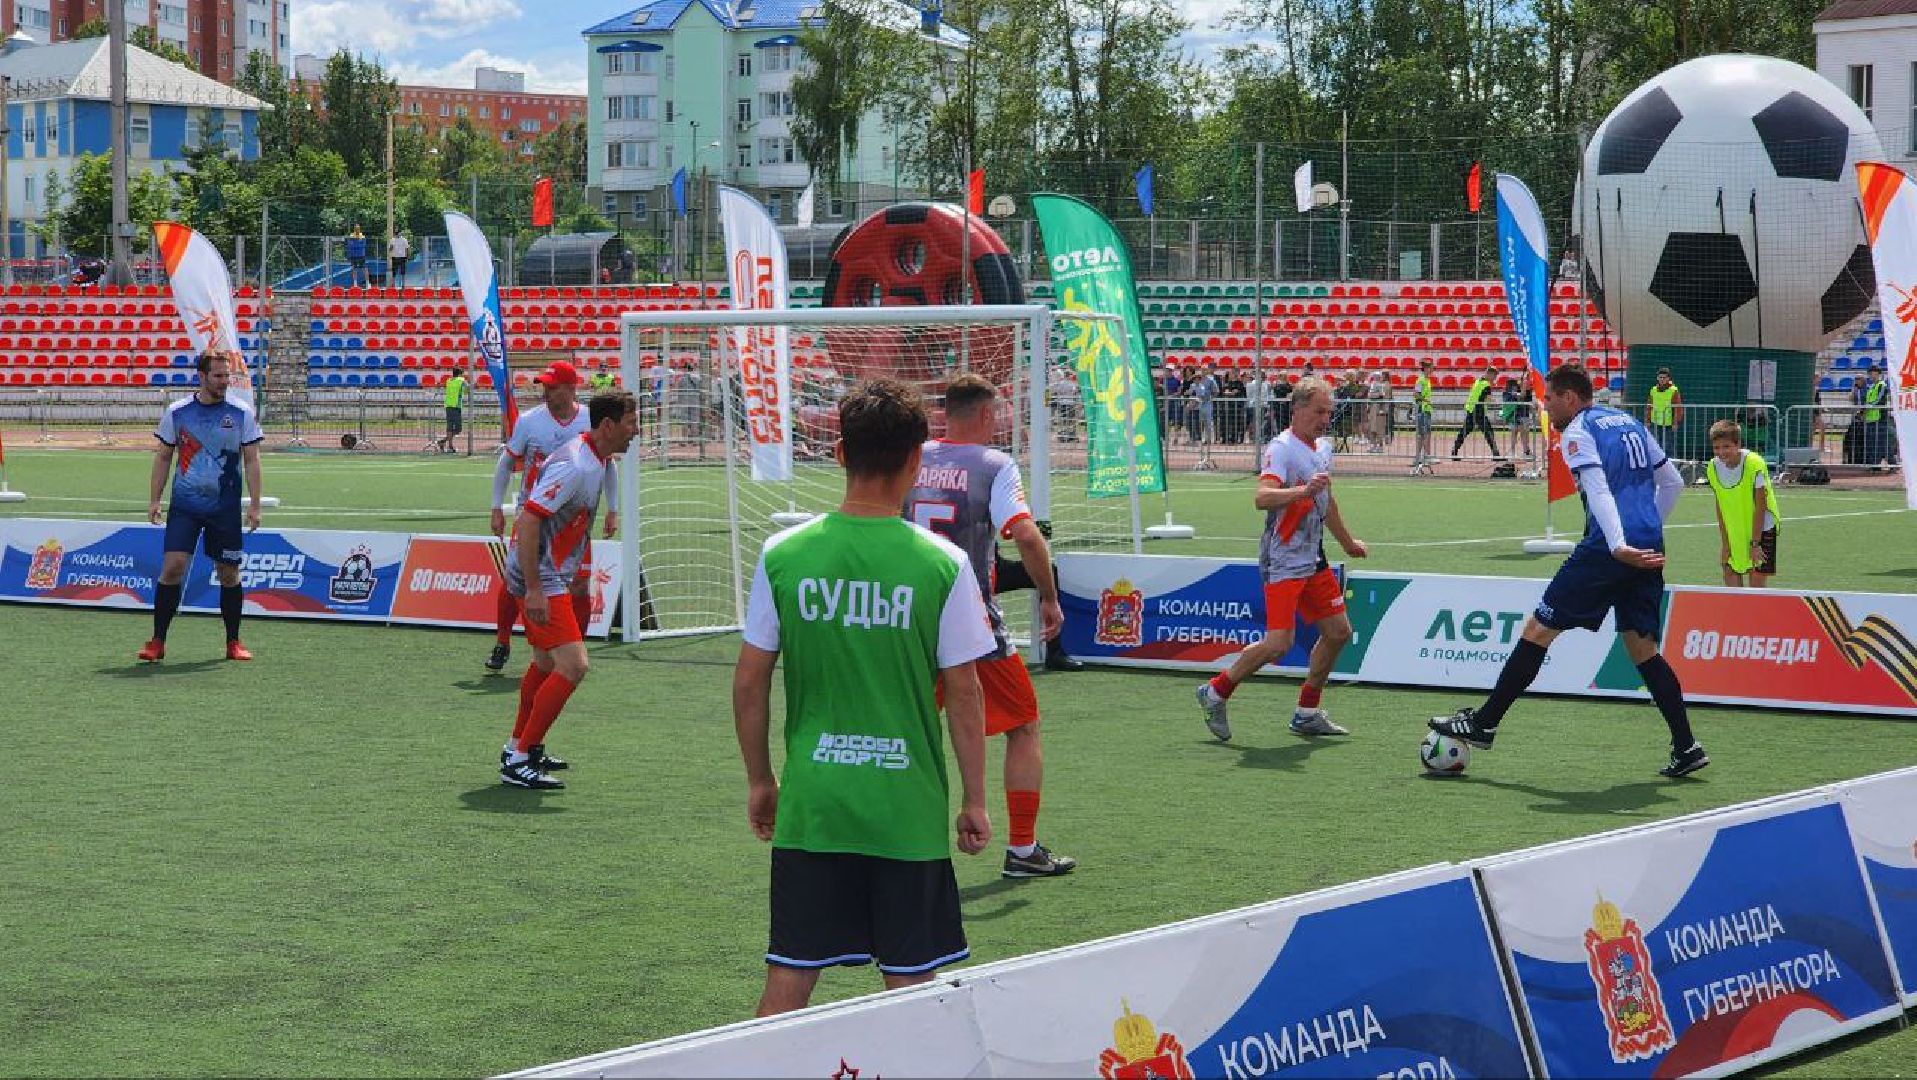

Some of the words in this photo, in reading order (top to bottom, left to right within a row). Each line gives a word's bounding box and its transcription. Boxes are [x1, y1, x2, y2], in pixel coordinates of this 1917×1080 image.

[1621, 431, 1648, 469] 10
[914, 466, 968, 492] АРЯКА
[72, 553, 134, 569] КОМАНДА
[238, 553, 305, 572] ОСОБЛ
[67, 572, 153, 589] ГУБЕРНАТОРА
[209, 570, 282, 589] СОРТ
[410, 568, 433, 591] 80
[432, 571, 492, 596] ПОБЕДА!
[798, 577, 914, 630] СУДЬЯ
[1159, 599, 1253, 621] КОМАНДА
[1156, 625, 1268, 645] ГУБЕРНАТО
[1425, 608, 1524, 645] лет
[1683, 629, 1719, 660] 80
[1721, 635, 1819, 665] ПОБЕДА!
[818, 732, 907, 754] МОСОБЛ
[1665, 903, 1785, 964] КОМАНДА
[1683, 949, 1841, 1025] ГУБЕРНАТОРА
[1218, 1004, 1386, 1079] КОМАНДА
